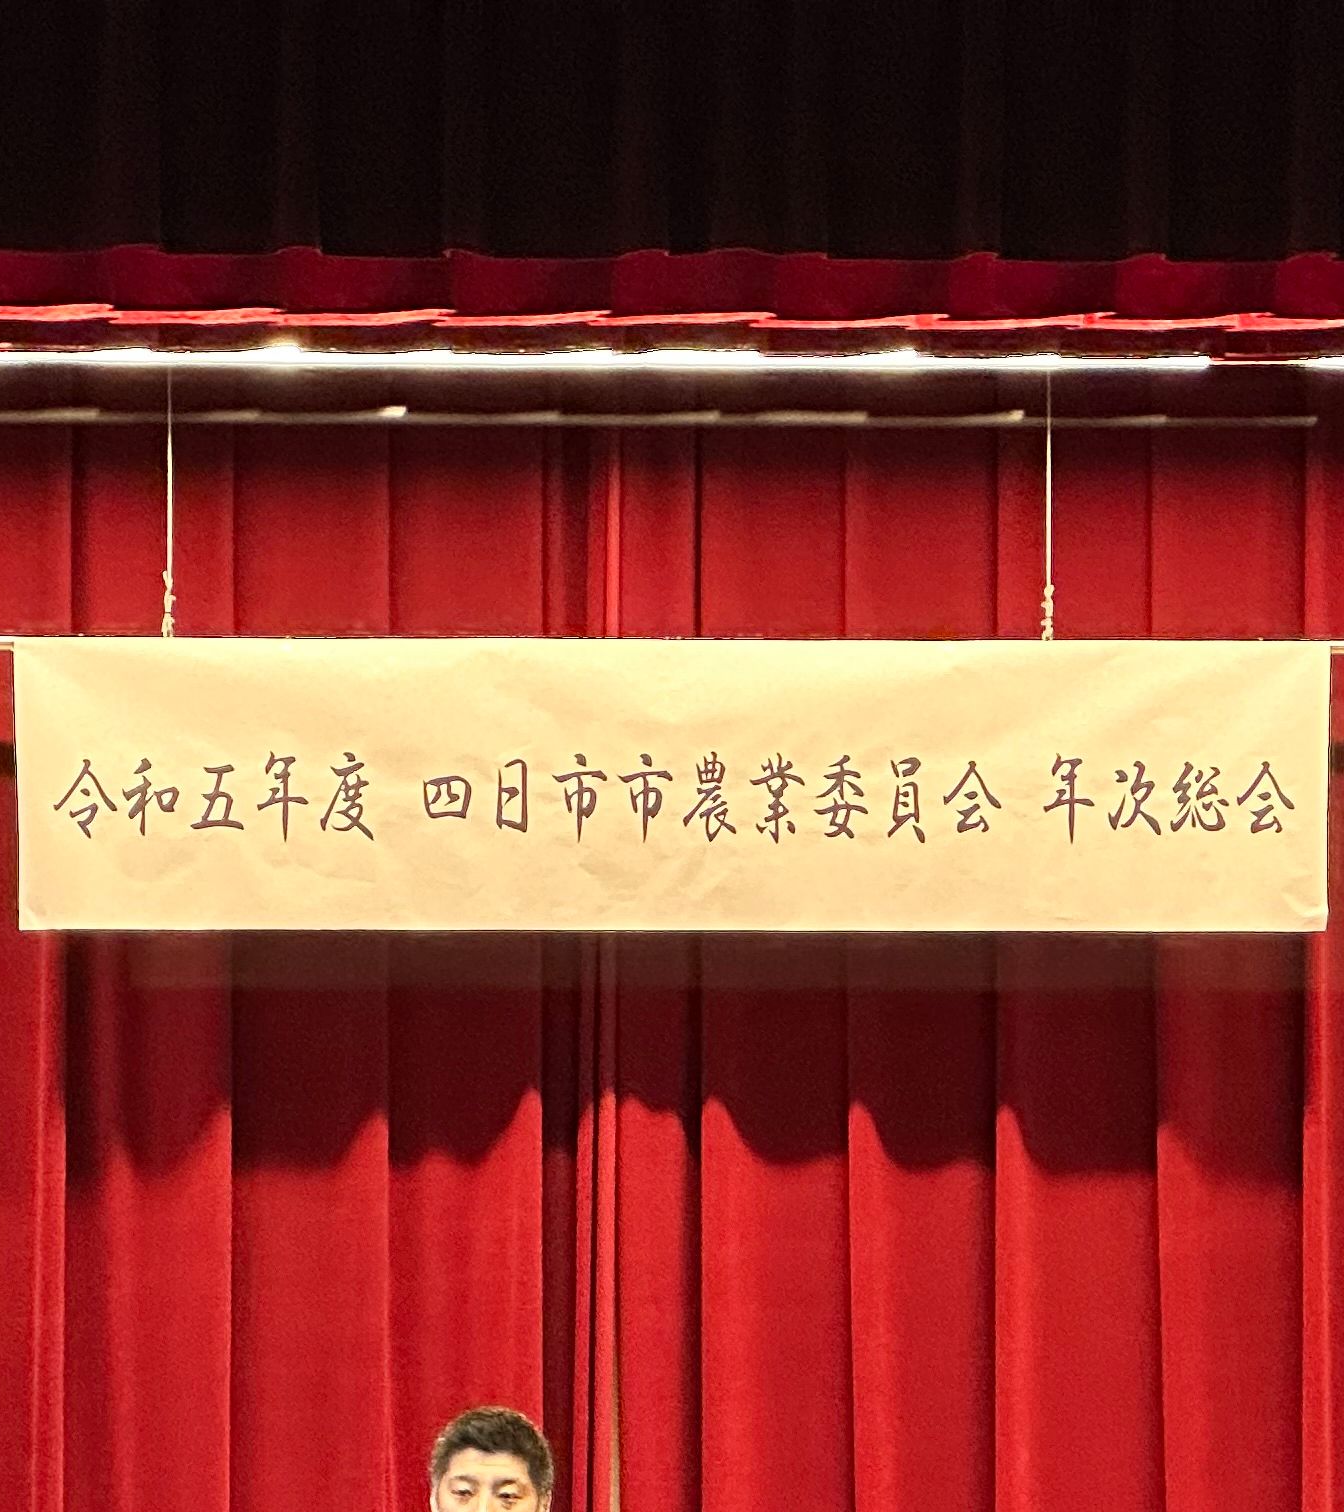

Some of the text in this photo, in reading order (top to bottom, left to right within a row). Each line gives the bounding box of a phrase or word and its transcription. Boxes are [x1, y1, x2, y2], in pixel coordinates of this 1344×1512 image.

[53, 751, 1295, 845] 令和五年度 四日市市農業委員会 年次総会
